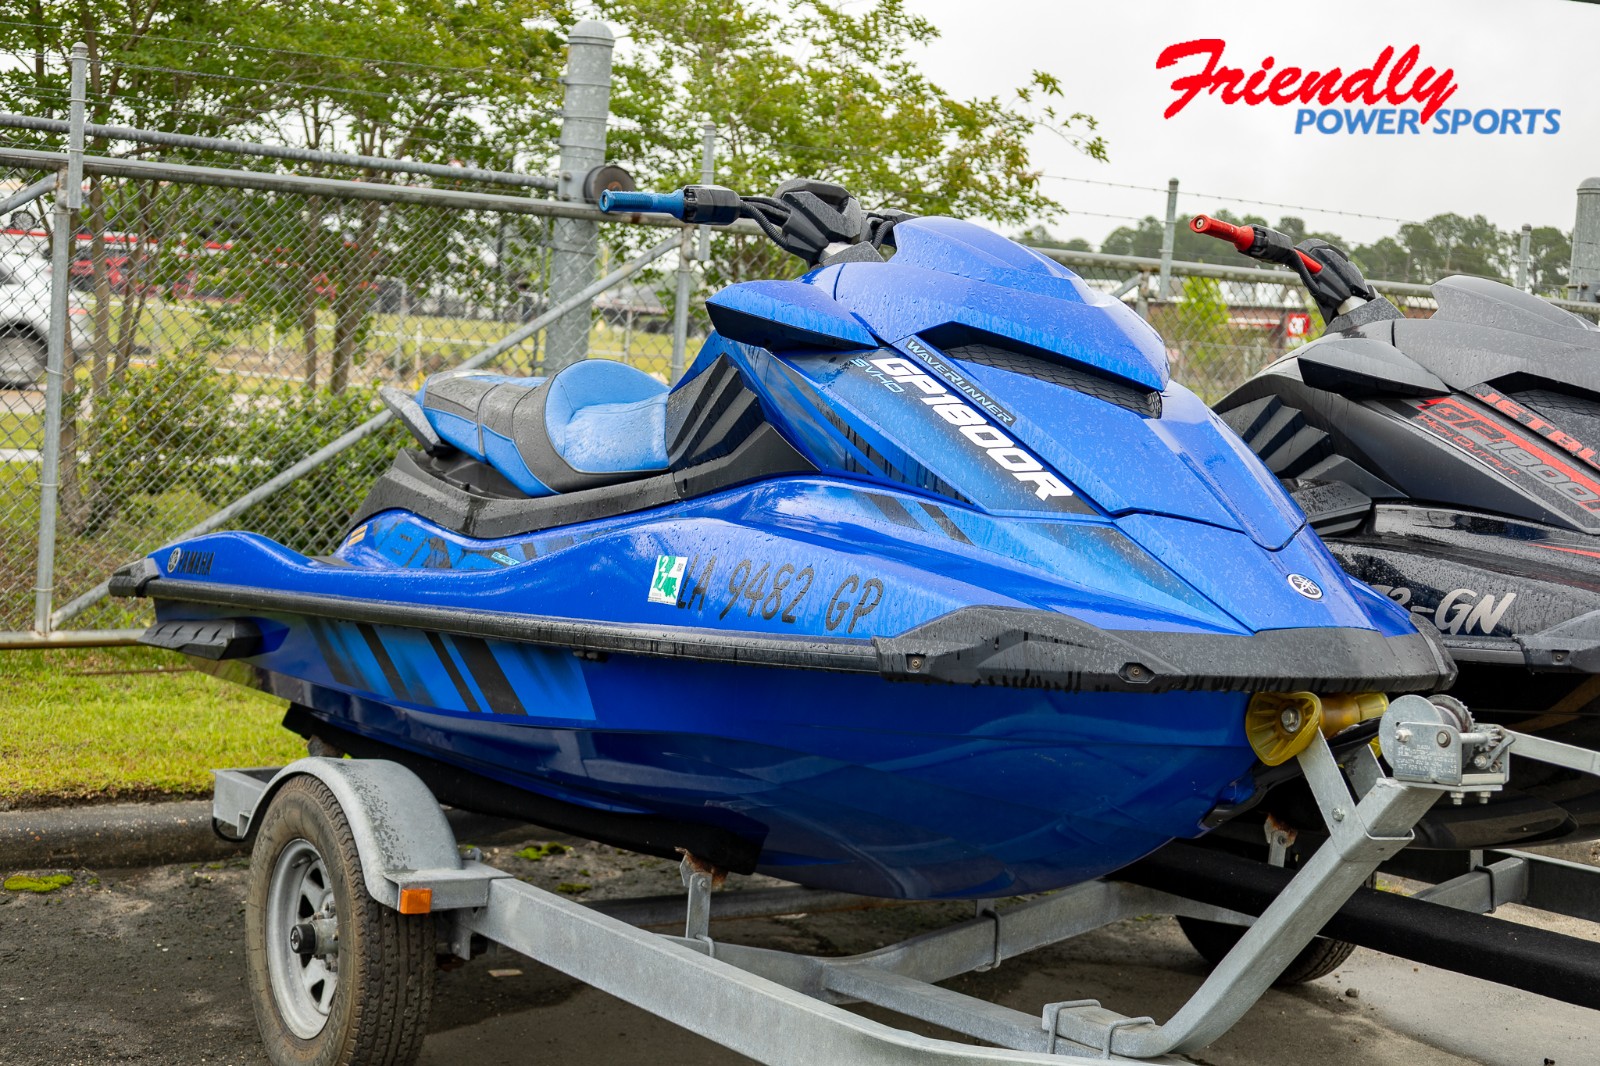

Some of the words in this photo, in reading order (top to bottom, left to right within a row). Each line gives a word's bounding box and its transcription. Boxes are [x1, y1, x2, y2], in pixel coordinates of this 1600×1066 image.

[850, 358, 905, 393] SVHO
[906, 341, 1013, 423] WAVERUNNER
[869, 357, 1074, 501] GP1800R
[1421, 402, 1600, 512] GP1800
[677, 554, 717, 611] LA
[719, 559, 814, 624] 9482
[825, 574, 883, 633] GP
